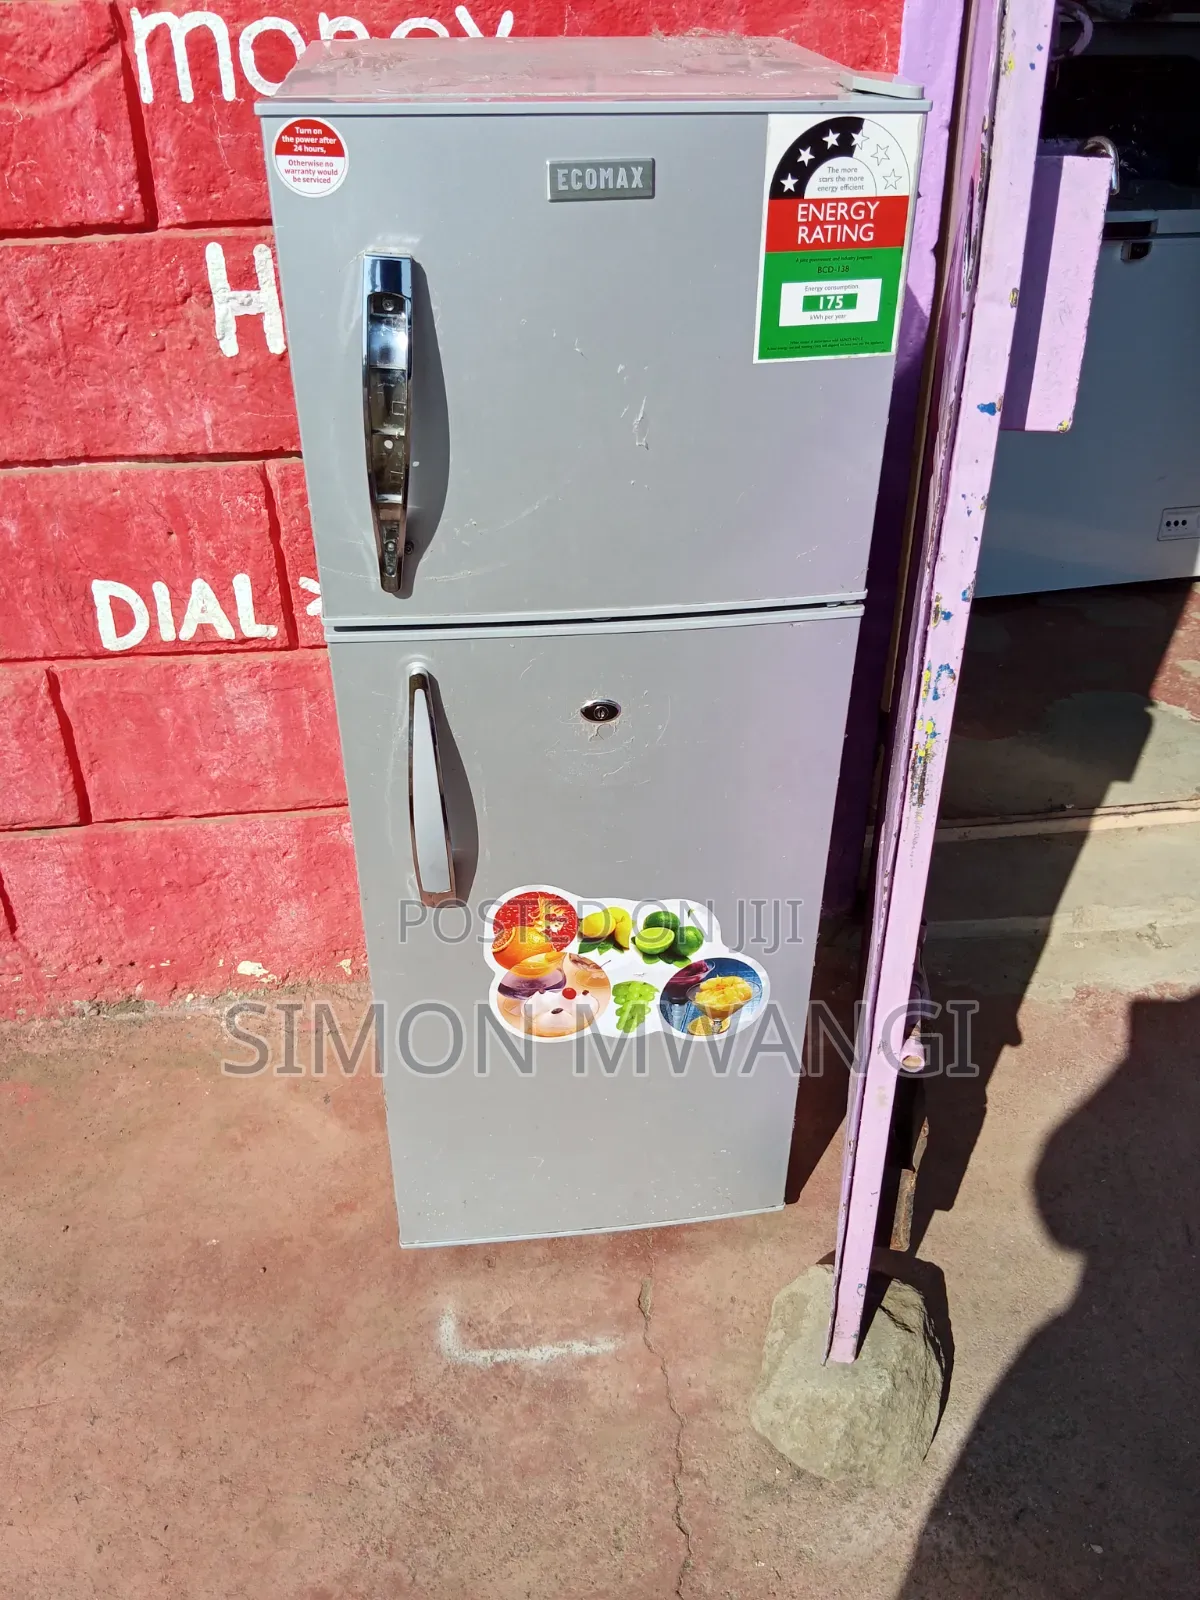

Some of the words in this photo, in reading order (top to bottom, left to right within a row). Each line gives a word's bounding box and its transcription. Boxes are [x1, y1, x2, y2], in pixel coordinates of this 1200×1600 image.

[288, 159, 324, 168] Otherwise
[284, 168, 316, 176] warranty
[317, 168, 339, 176] would
[302, 176, 331, 184] serviced
[556, 166, 644, 191] ECOMAX
[797, 201, 880, 222] ENERGY
[797, 223, 874, 244] RATING
[817, 265, 850, 274] BCD-138
[824, 284, 859, 292] consumption
[818, 295, 844, 310] 175
[91, 573, 279, 651] DIAL
